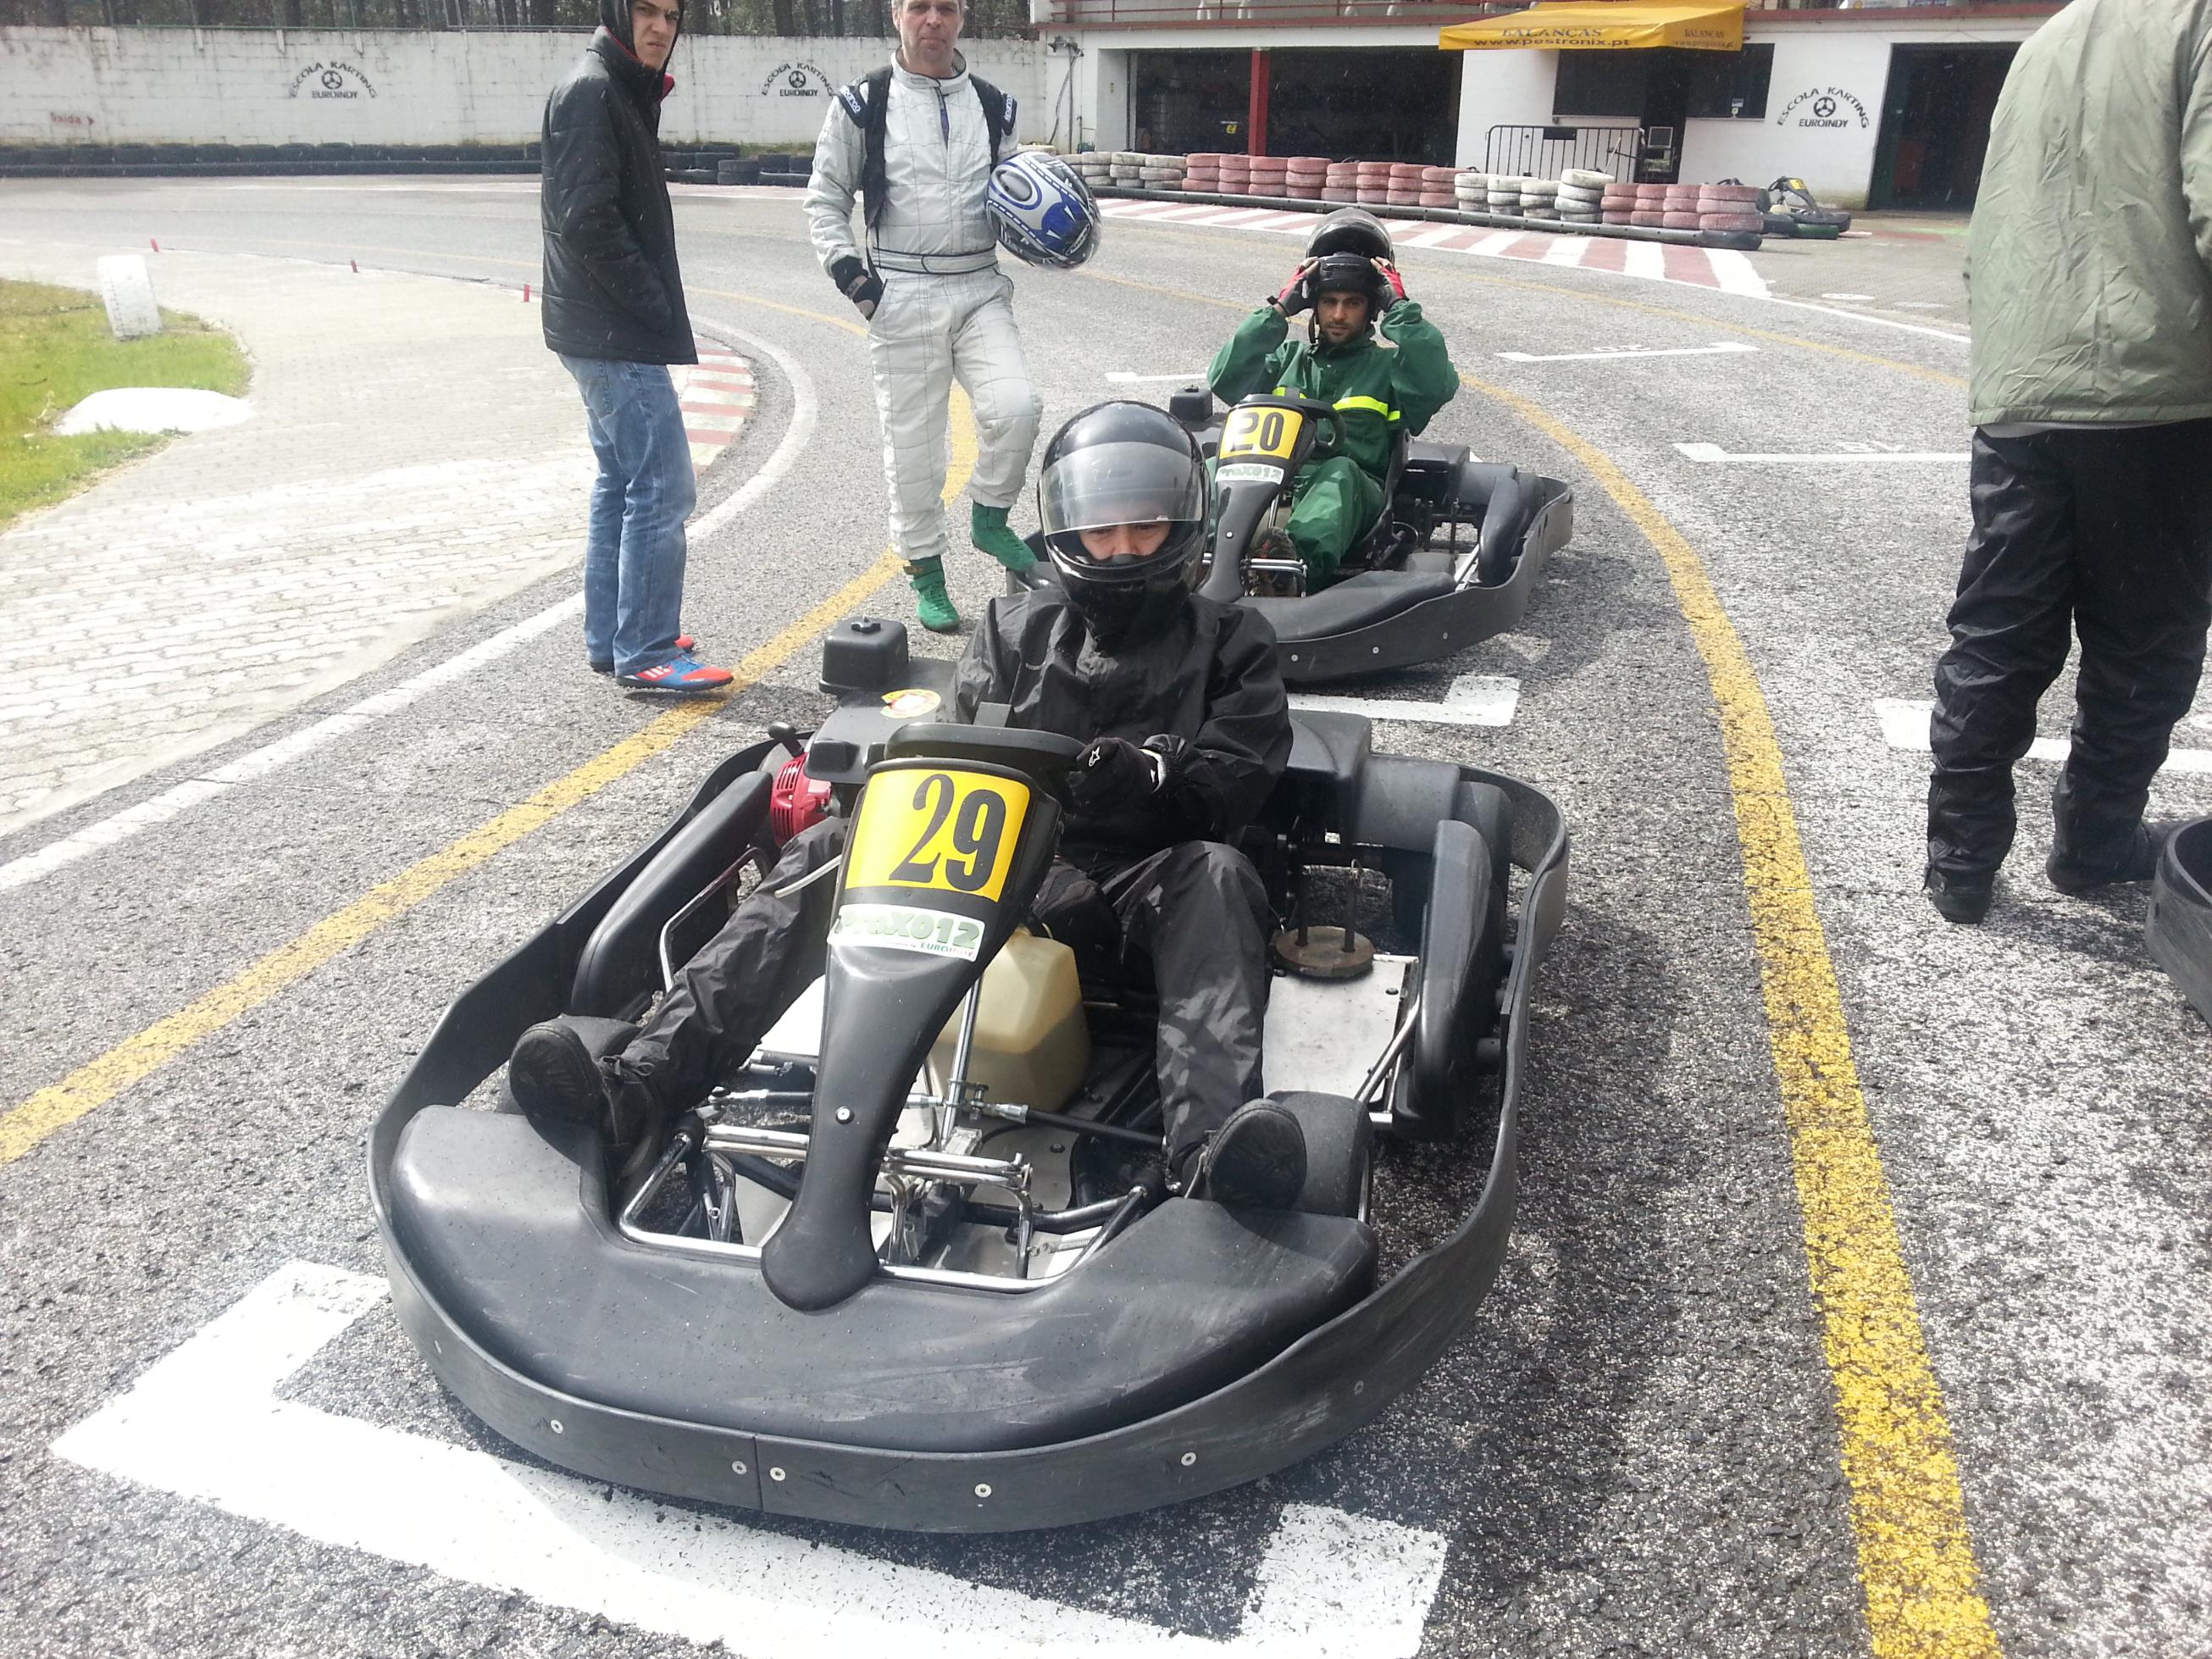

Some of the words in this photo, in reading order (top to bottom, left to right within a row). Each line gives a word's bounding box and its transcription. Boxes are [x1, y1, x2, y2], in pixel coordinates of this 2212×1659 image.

[290, 62, 324, 98] ESCOLA
[330, 61, 378, 98] KARTING
[312, 91, 358, 99] EUROINDY
[762, 64, 791, 96] ESCOLA
[796, 62, 834, 97] KARTING
[1777, 88, 1819, 126] ESCOLA
[1827, 86, 1870, 129] KARTING
[1799, 119, 1849, 128] EUROINDY
[1230, 412, 1284, 452] 20
[889, 774, 1006, 892] 29
